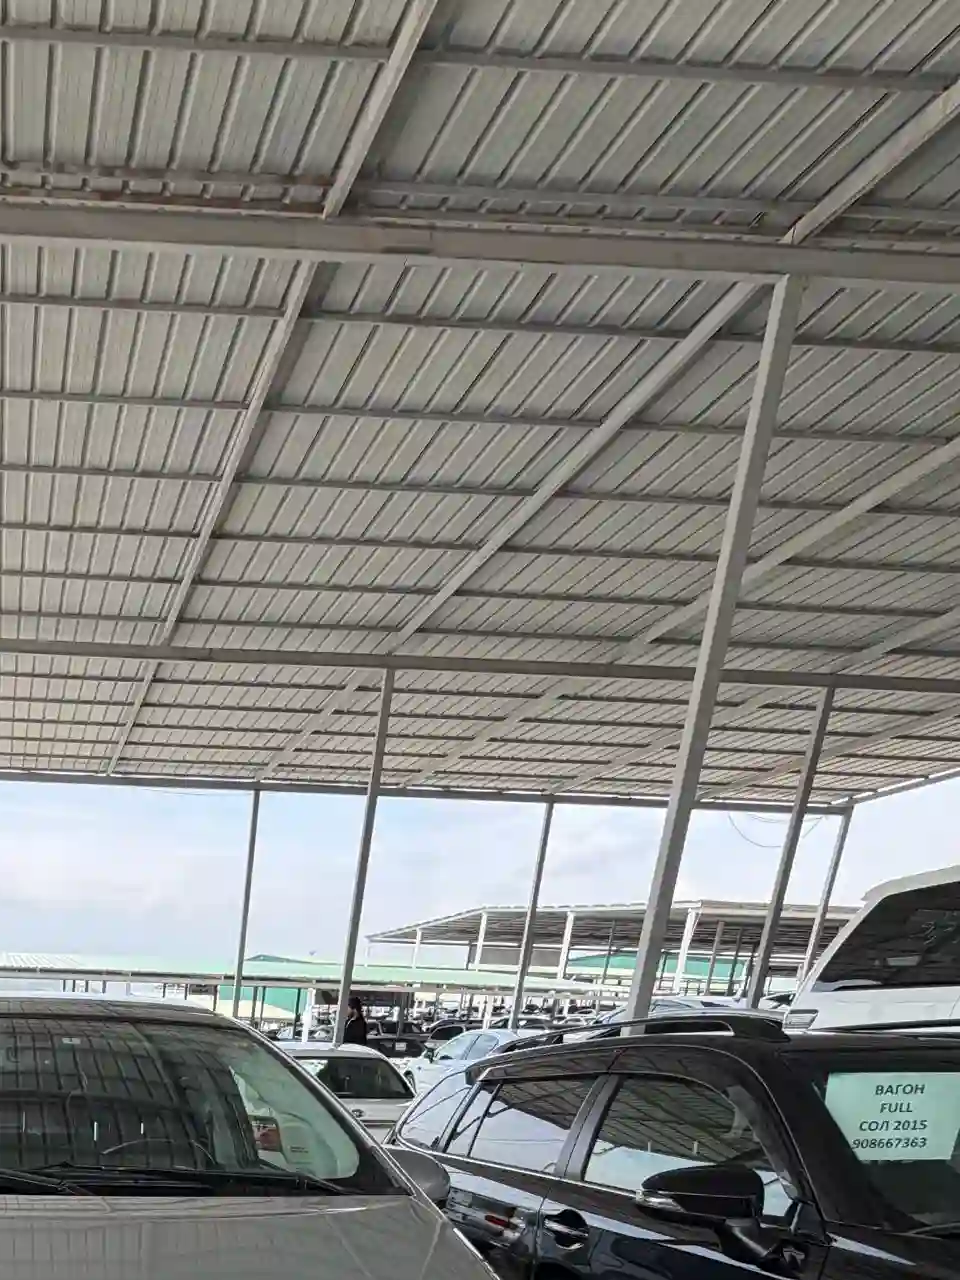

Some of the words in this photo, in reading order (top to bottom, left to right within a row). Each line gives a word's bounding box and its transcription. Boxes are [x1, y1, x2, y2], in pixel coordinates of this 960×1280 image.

[875, 1084, 926, 1096] ВАГОН
[880, 1102, 913, 1113] FULL
[859, 1120, 889, 1131] СОЛ
[893, 1119, 928, 1131] 2015
[852, 1137, 928, 1149] 908667363
